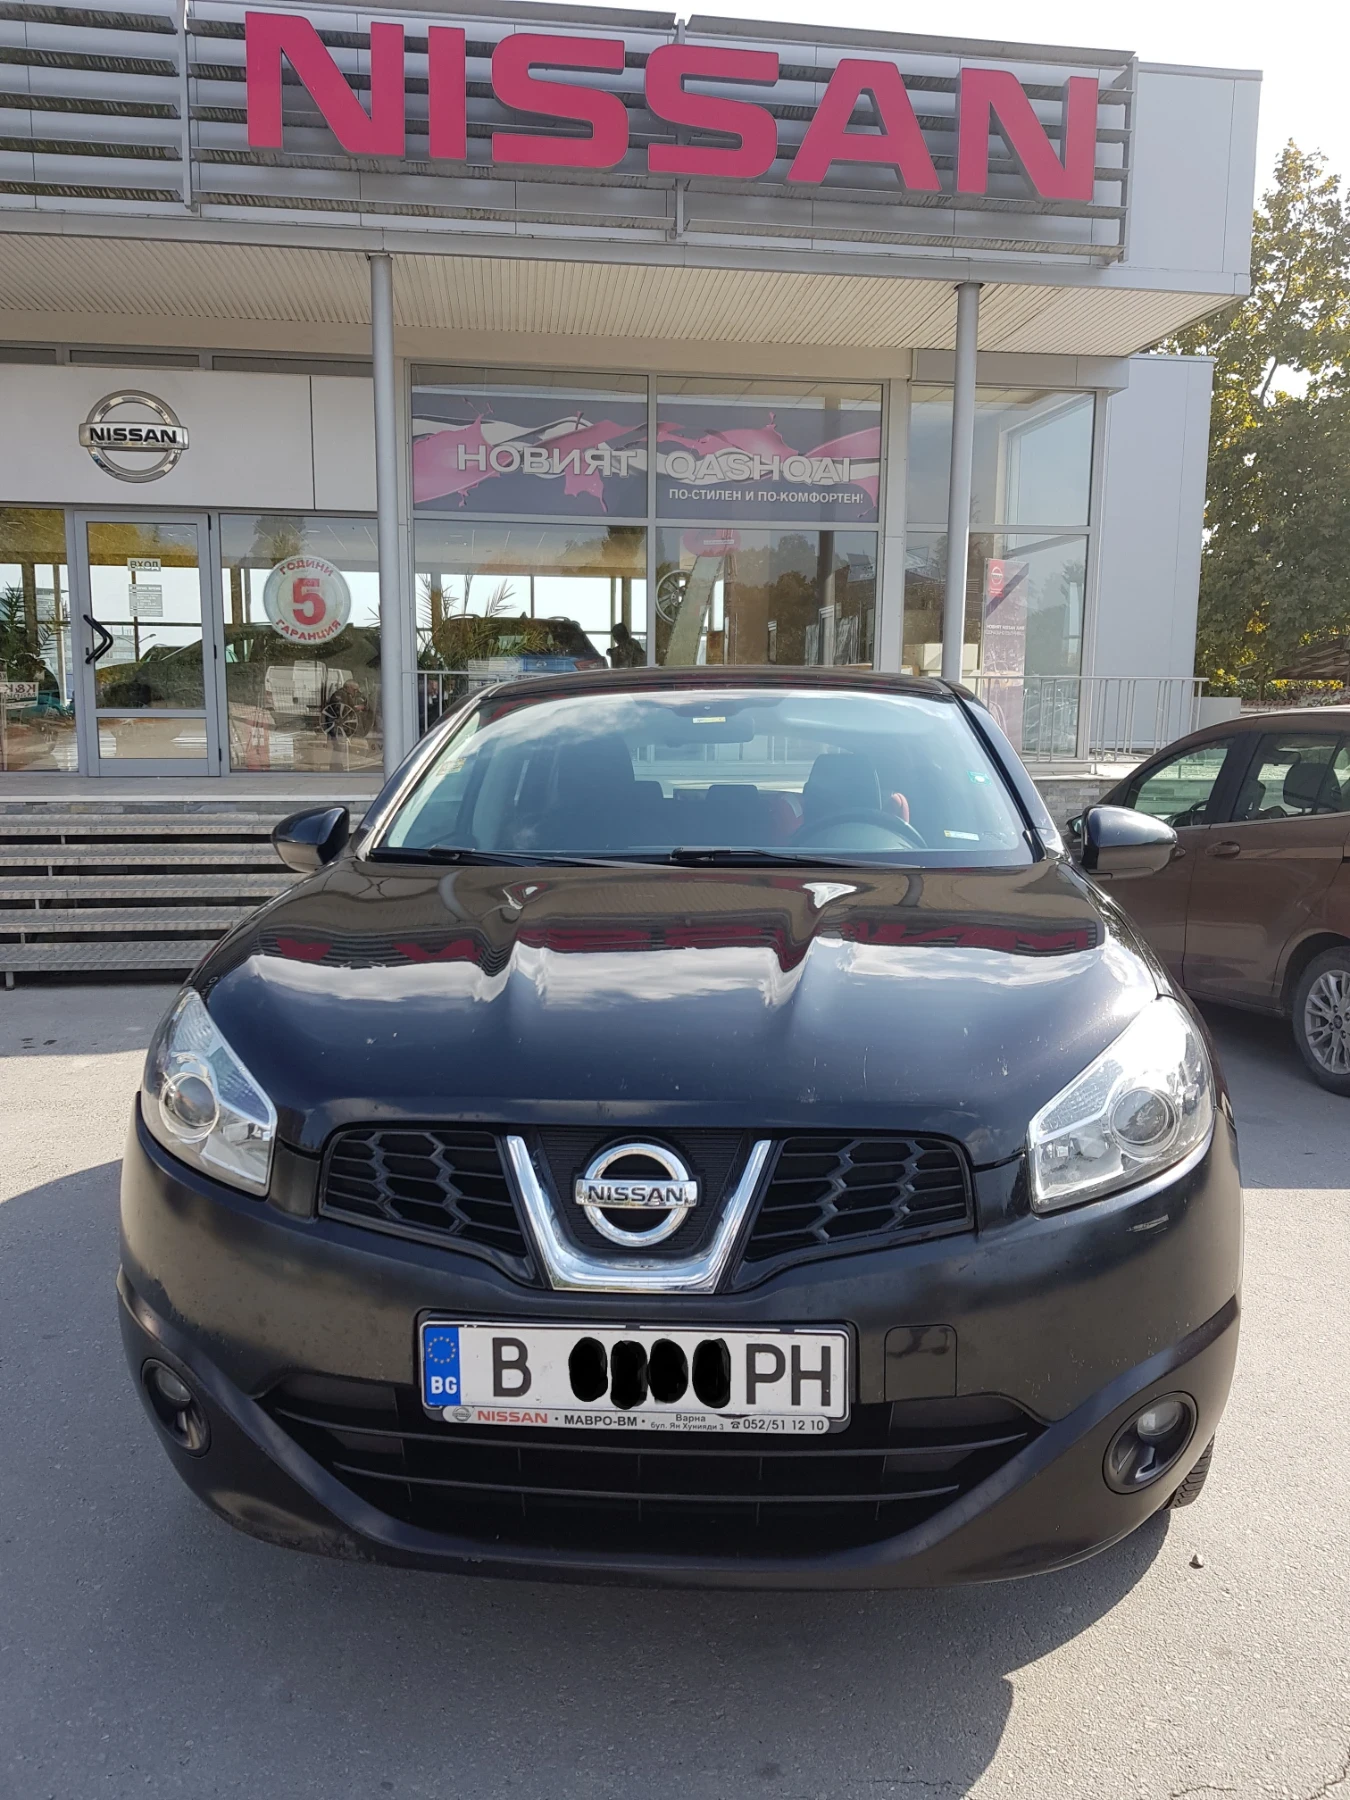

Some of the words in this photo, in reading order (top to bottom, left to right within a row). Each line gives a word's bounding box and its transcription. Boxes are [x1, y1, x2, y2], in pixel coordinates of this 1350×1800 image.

[245, 12, 1097, 201] NISSAN
[90, 427, 177, 443] NISSAN
[457, 444, 638, 478] НОВИЯТ
[665, 450, 851, 486] QASHQAI
[669, 489, 742, 501] ПО-СТИЛЕН
[746, 491, 754, 501] И
[758, 491, 864, 504] ПО-КОМФОРТЕН!
[280, 560, 334, 577] ГОДИНИ
[293, 577, 327, 626] 5
[276, 618, 341, 641] ГАРАНЦИЯ
[588, 1185, 684, 1203] NISSAN
[492, 1336, 532, 1397] B
[746, 1343, 831, 1407] PH
[431, 1376, 458, 1394] BG
[477, 1410, 548, 1424] NISSAN
[564, 1414, 638, 1427] МАВРО-ВМ
[650, 1421, 668, 1431] бул.
[669, 1422, 681, 1430] Ян
[675, 1413, 706, 1424] Варна
[743, 1418, 785, 1431] 052/51
[791, 1419, 805, 1431] 12
[811, 1420, 825, 1431] 10
